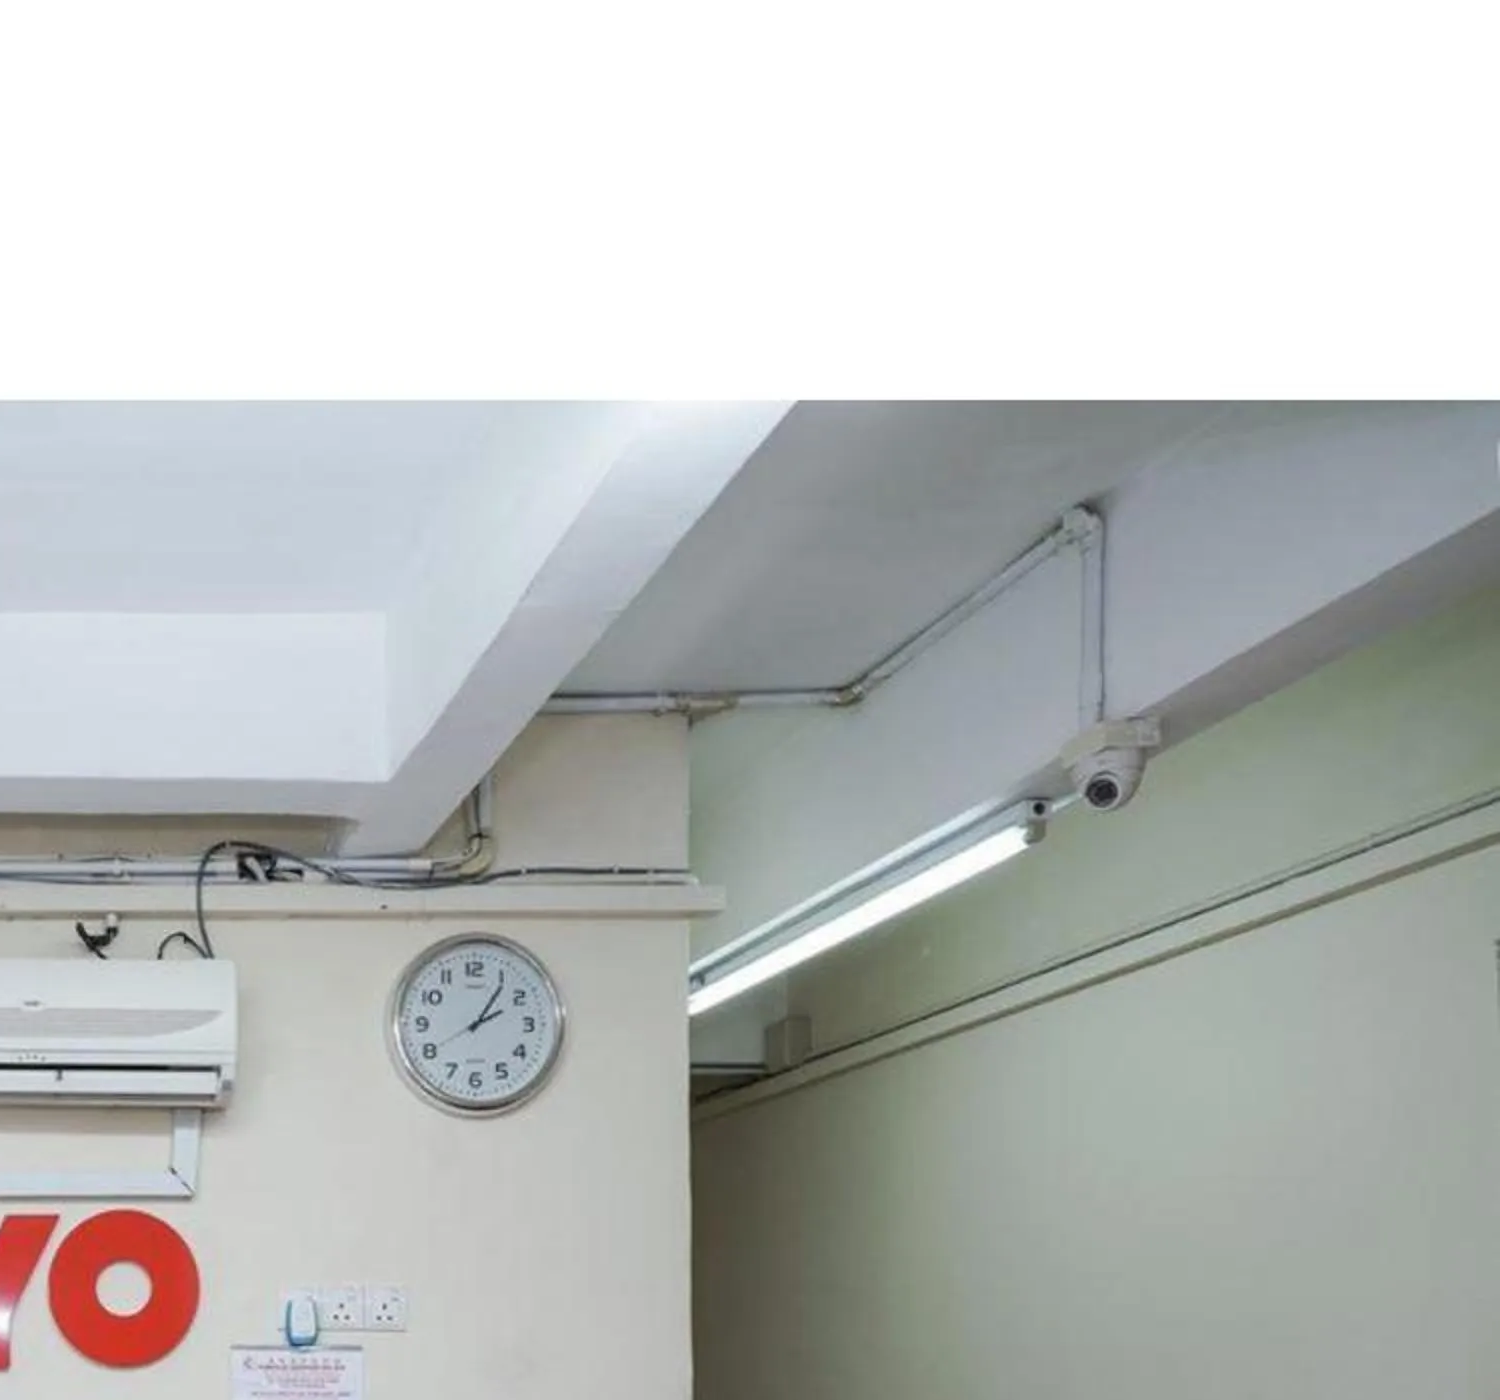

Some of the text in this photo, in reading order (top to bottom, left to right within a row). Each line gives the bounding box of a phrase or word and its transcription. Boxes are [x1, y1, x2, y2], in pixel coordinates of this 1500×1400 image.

[441, 969, 452, 984] 11
[465, 961, 484, 977] 12
[422, 989, 443, 1006] 10
[513, 990, 526, 1006] 2
[415, 1015, 430, 1033] 9
[522, 1016, 535, 1033] 3
[422, 1043, 437, 1060] 8
[512, 1043, 526, 1060] 4
[445, 1062, 459, 1079] 7
[495, 1062, 509, 1080] 5
[468, 1071, 483, 1088] 6
